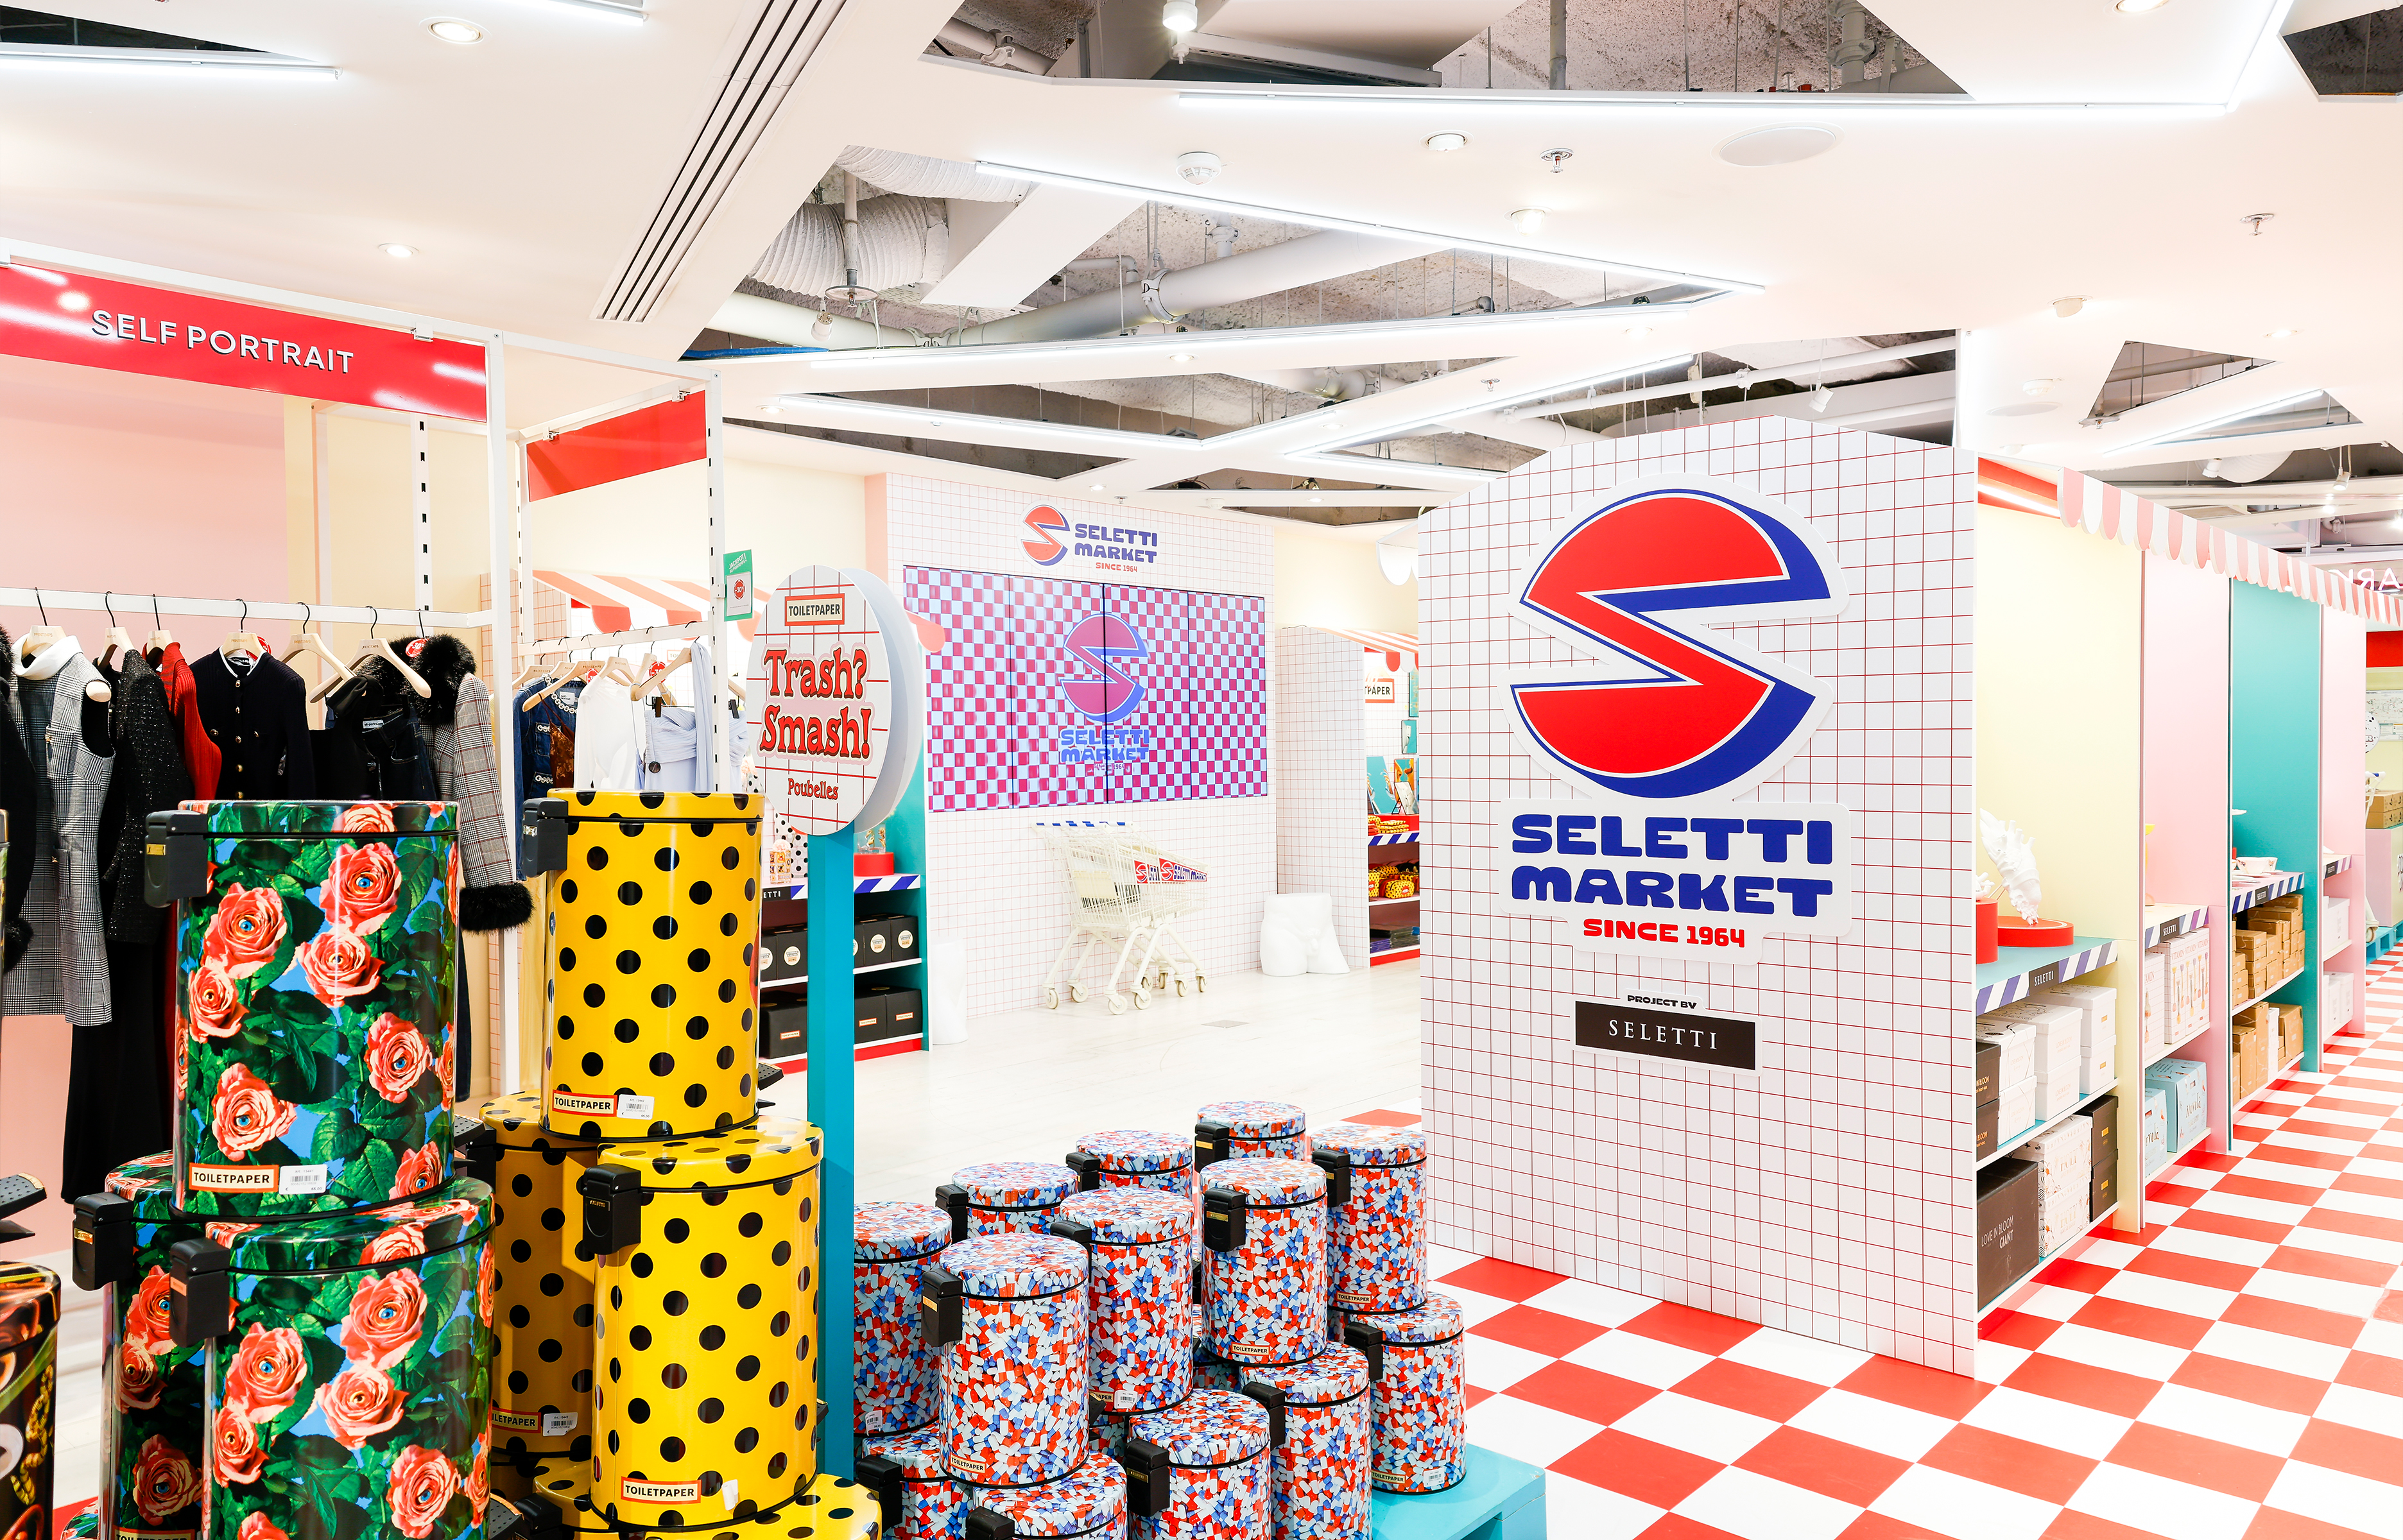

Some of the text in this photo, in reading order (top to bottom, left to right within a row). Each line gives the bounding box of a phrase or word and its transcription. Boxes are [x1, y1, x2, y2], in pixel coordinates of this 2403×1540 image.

[92, 310, 354, 374] SELF PORTRAIT
[1075, 524, 1157, 547] SELETTI
[1074, 543, 1157, 563] MARKET
[1096, 562, 1121, 570] SINCE
[788, 604, 840, 617] TOILETPAPER
[764, 647, 866, 699] Trash?
[759, 705, 871, 759] Smash!
[1061, 730, 1149, 745] SELETTI
[1061, 748, 1149, 762] MARKET
[788, 778, 839, 800] Poubelles
[1512, 813, 1833, 865] SELETTI
[1512, 865, 1834, 918] MARKET
[1583, 918, 1745, 948] SINCE 1964
[2163, 924, 2176, 936] SELETTI
[2034, 970, 2054, 986] SELETTI
[1627, 995, 1697, 1009] PROJECT BY
[1608, 1020, 1717, 1050] SELETTI
[555, 1097, 611, 1109] TOILETPAPER
[194, 1172, 270, 1183] TOILETPAPER
[1981, 1215, 2014, 1247] LOVE IN BLOOM
[1999, 1229, 2013, 1249] GIANT
[1338, 1294, 1370, 1302] TOILETPAPER
[1233, 1345, 1268, 1353] TOILETPAPER
[492, 1413, 535, 1426] ILETPAPER
[951, 1457, 984, 1471] TOILETPAPER
[1372, 1471, 1404, 1482] TOILETPAPER
[626, 1485, 694, 1497] TOILETPAPER
